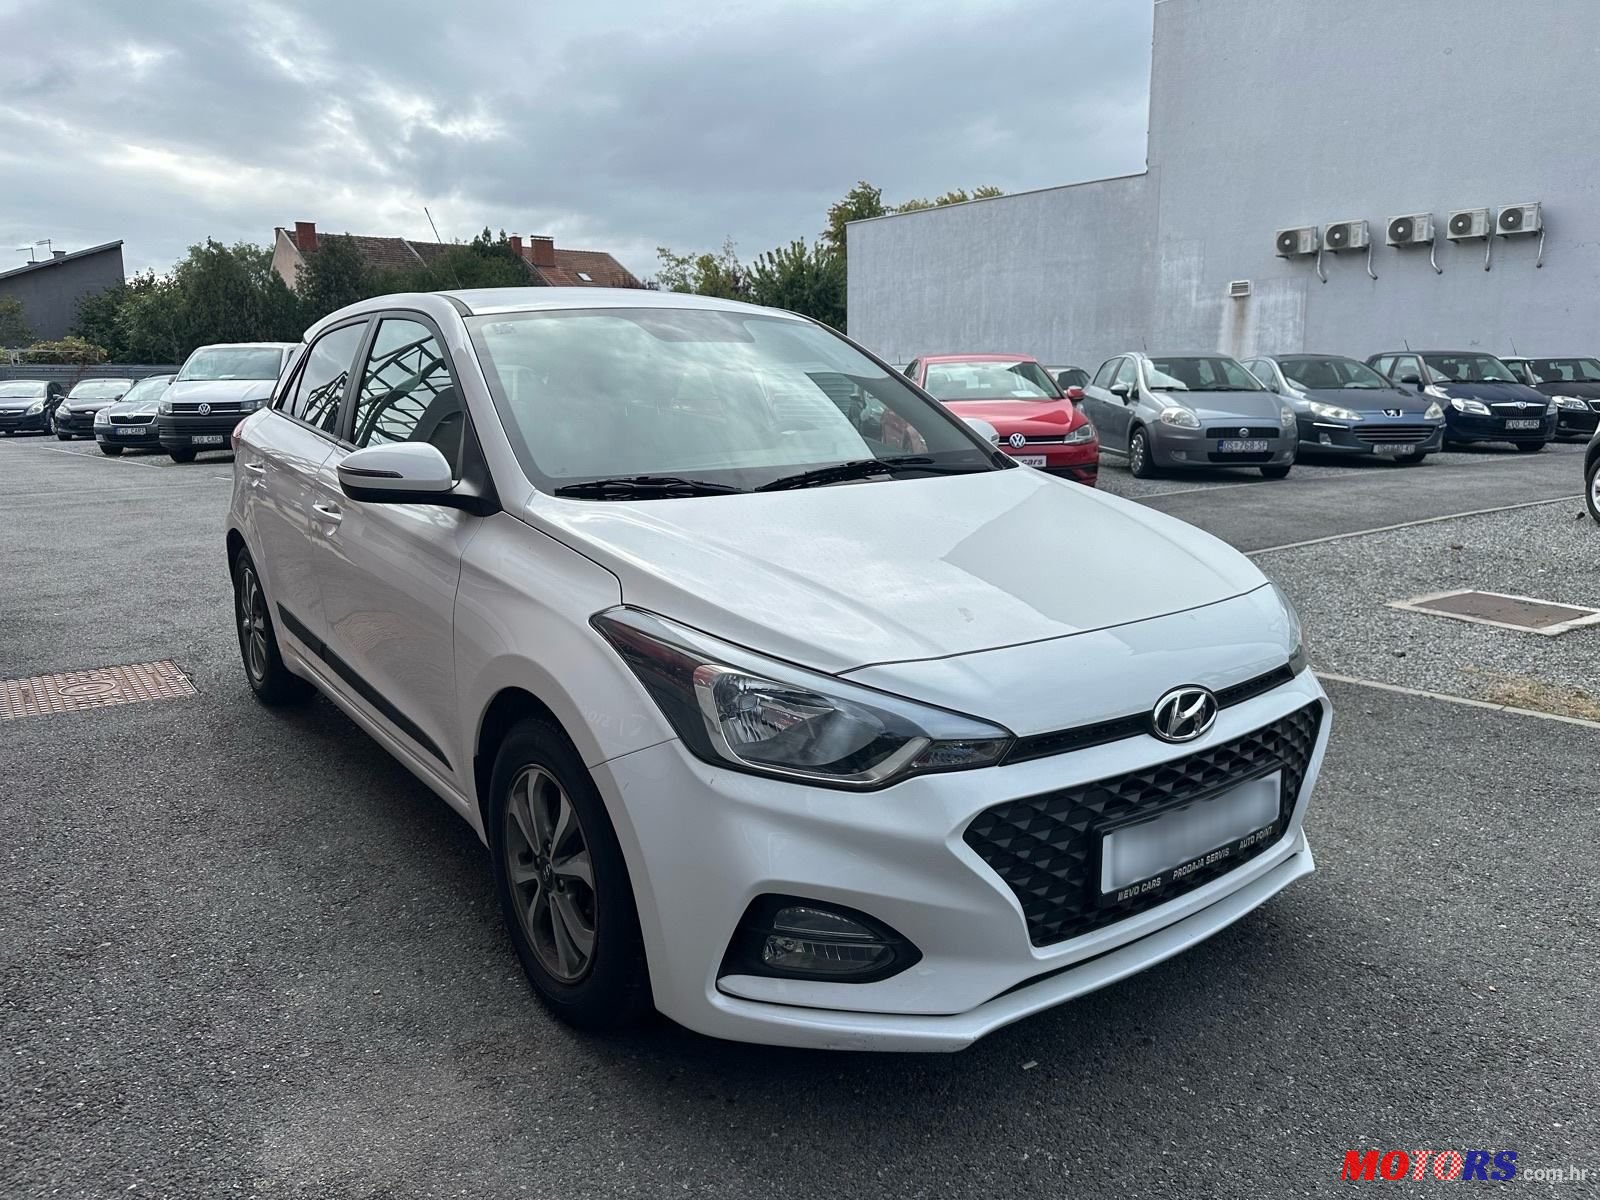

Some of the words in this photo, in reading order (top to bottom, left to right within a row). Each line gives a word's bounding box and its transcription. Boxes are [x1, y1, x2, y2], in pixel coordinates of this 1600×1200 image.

[1141, 877, 1161, 892] CARS
[1173, 858, 1205, 880] PRODAJA
[1206, 847, 1230, 864] SERVIS
[1239, 835, 1255, 850] AUTO
[1256, 826, 1273, 842] POINT
